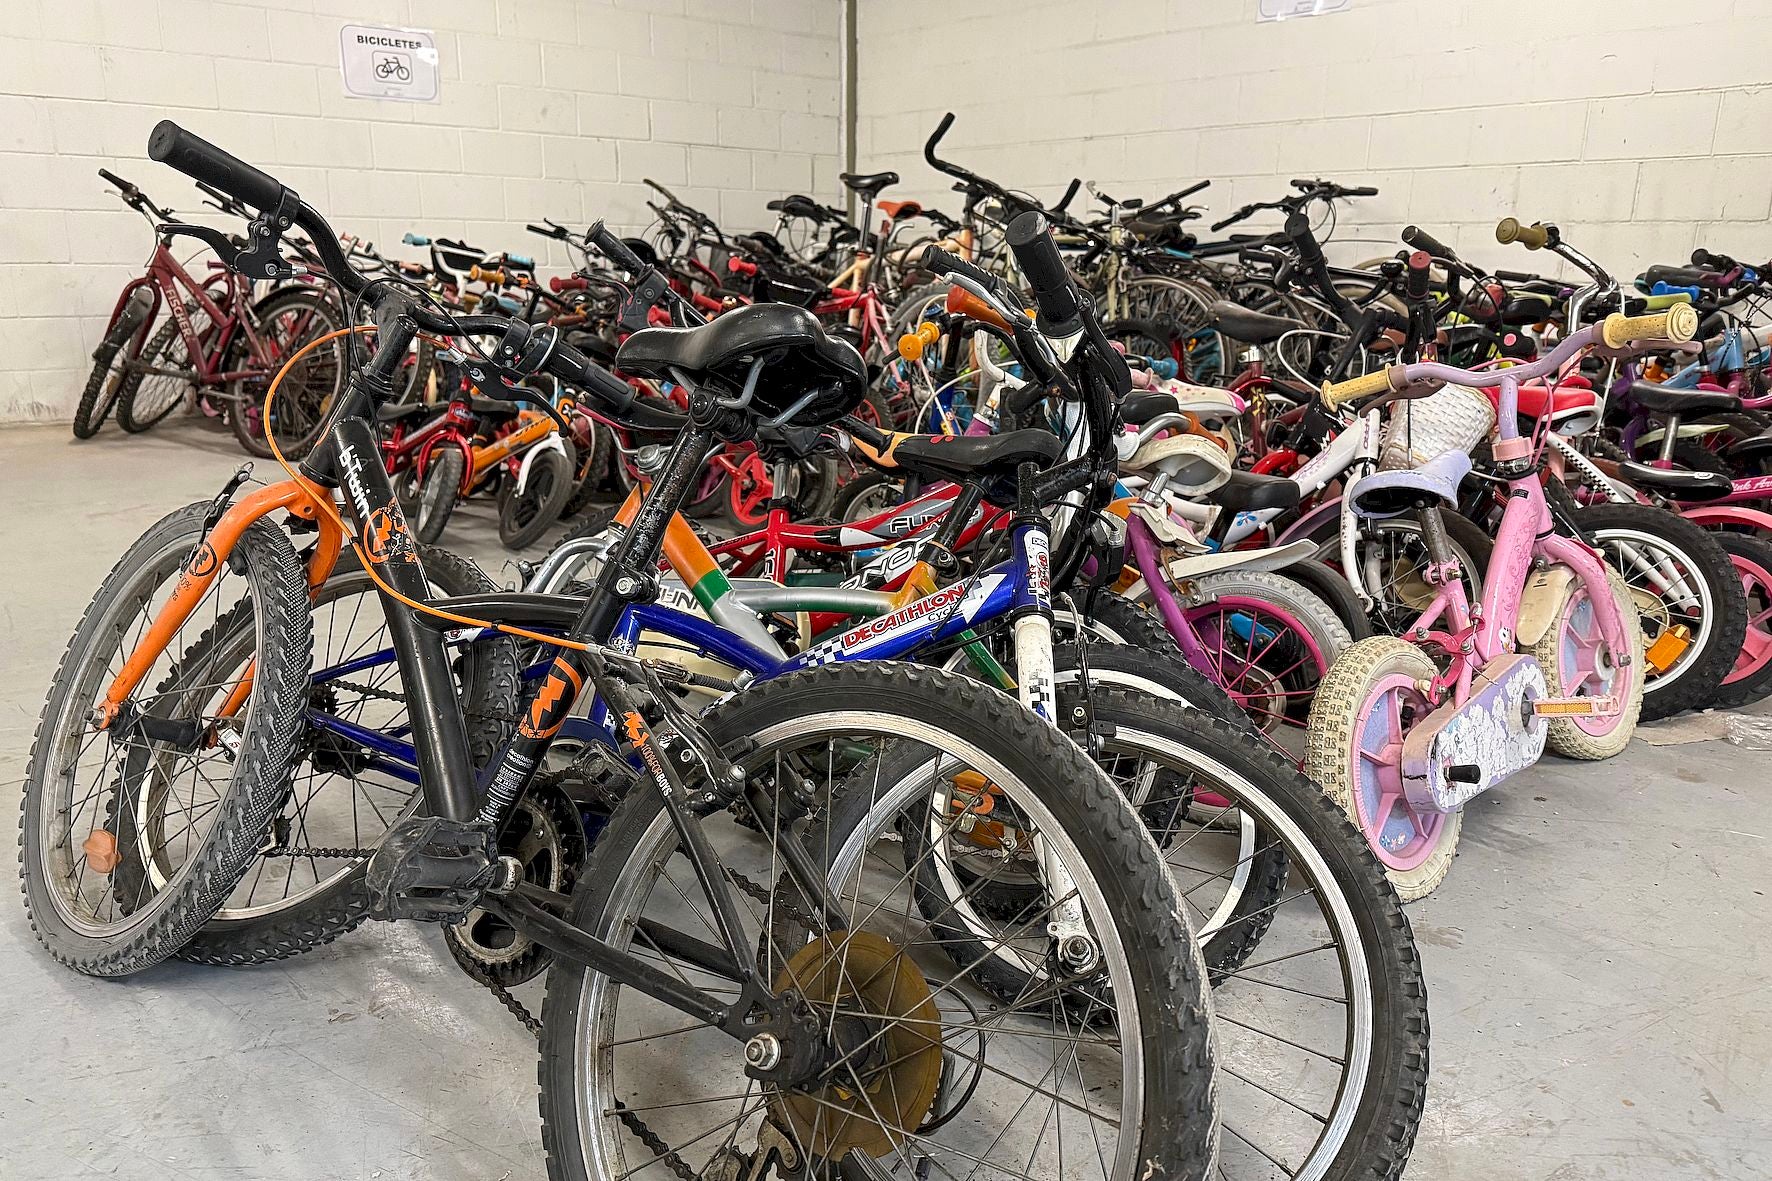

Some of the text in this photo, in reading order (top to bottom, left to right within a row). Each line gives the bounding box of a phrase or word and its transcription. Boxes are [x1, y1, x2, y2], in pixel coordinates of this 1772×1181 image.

[357, 35, 422, 50] BICICLETES
[166, 289, 192, 338] FISCHER
[843, 584, 967, 648] DECATHLON
